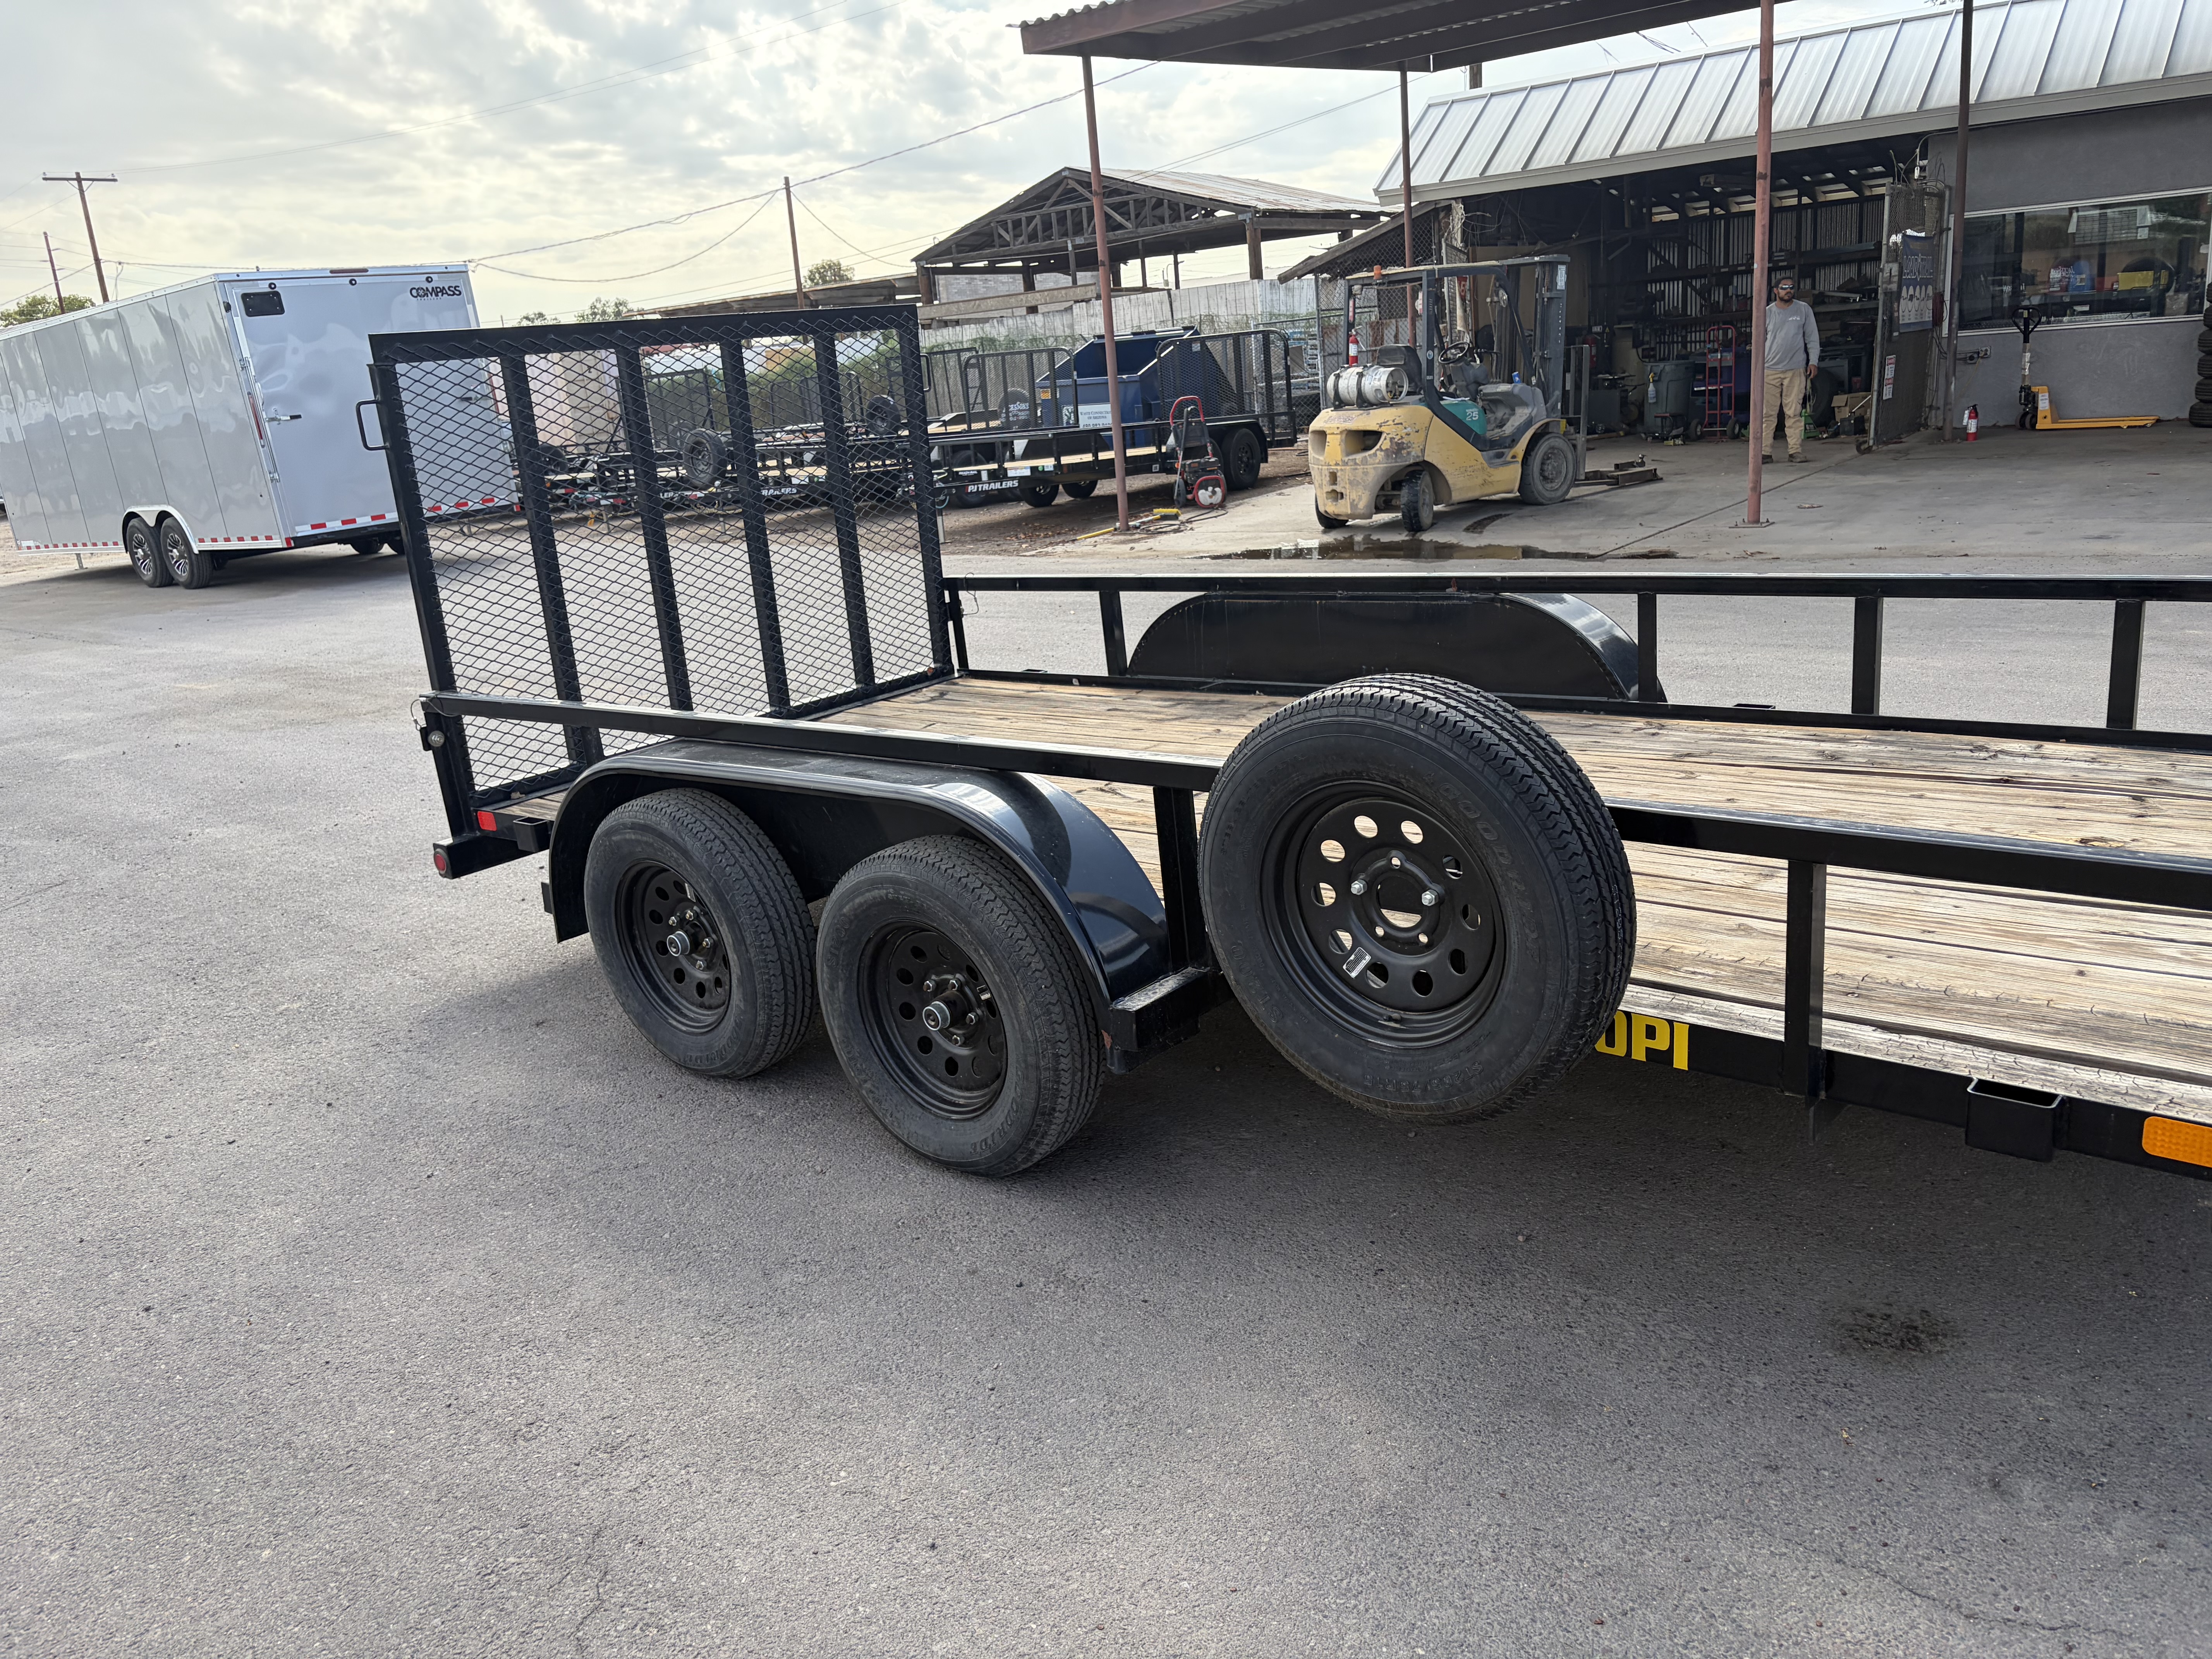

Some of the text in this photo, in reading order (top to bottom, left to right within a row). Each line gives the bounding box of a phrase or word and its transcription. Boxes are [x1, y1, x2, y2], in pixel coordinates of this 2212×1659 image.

[410, 285, 462, 298] COMPASS
[1466, 412, 1479, 421] 25
[968, 480, 1019, 493] PJ TRAILERS
